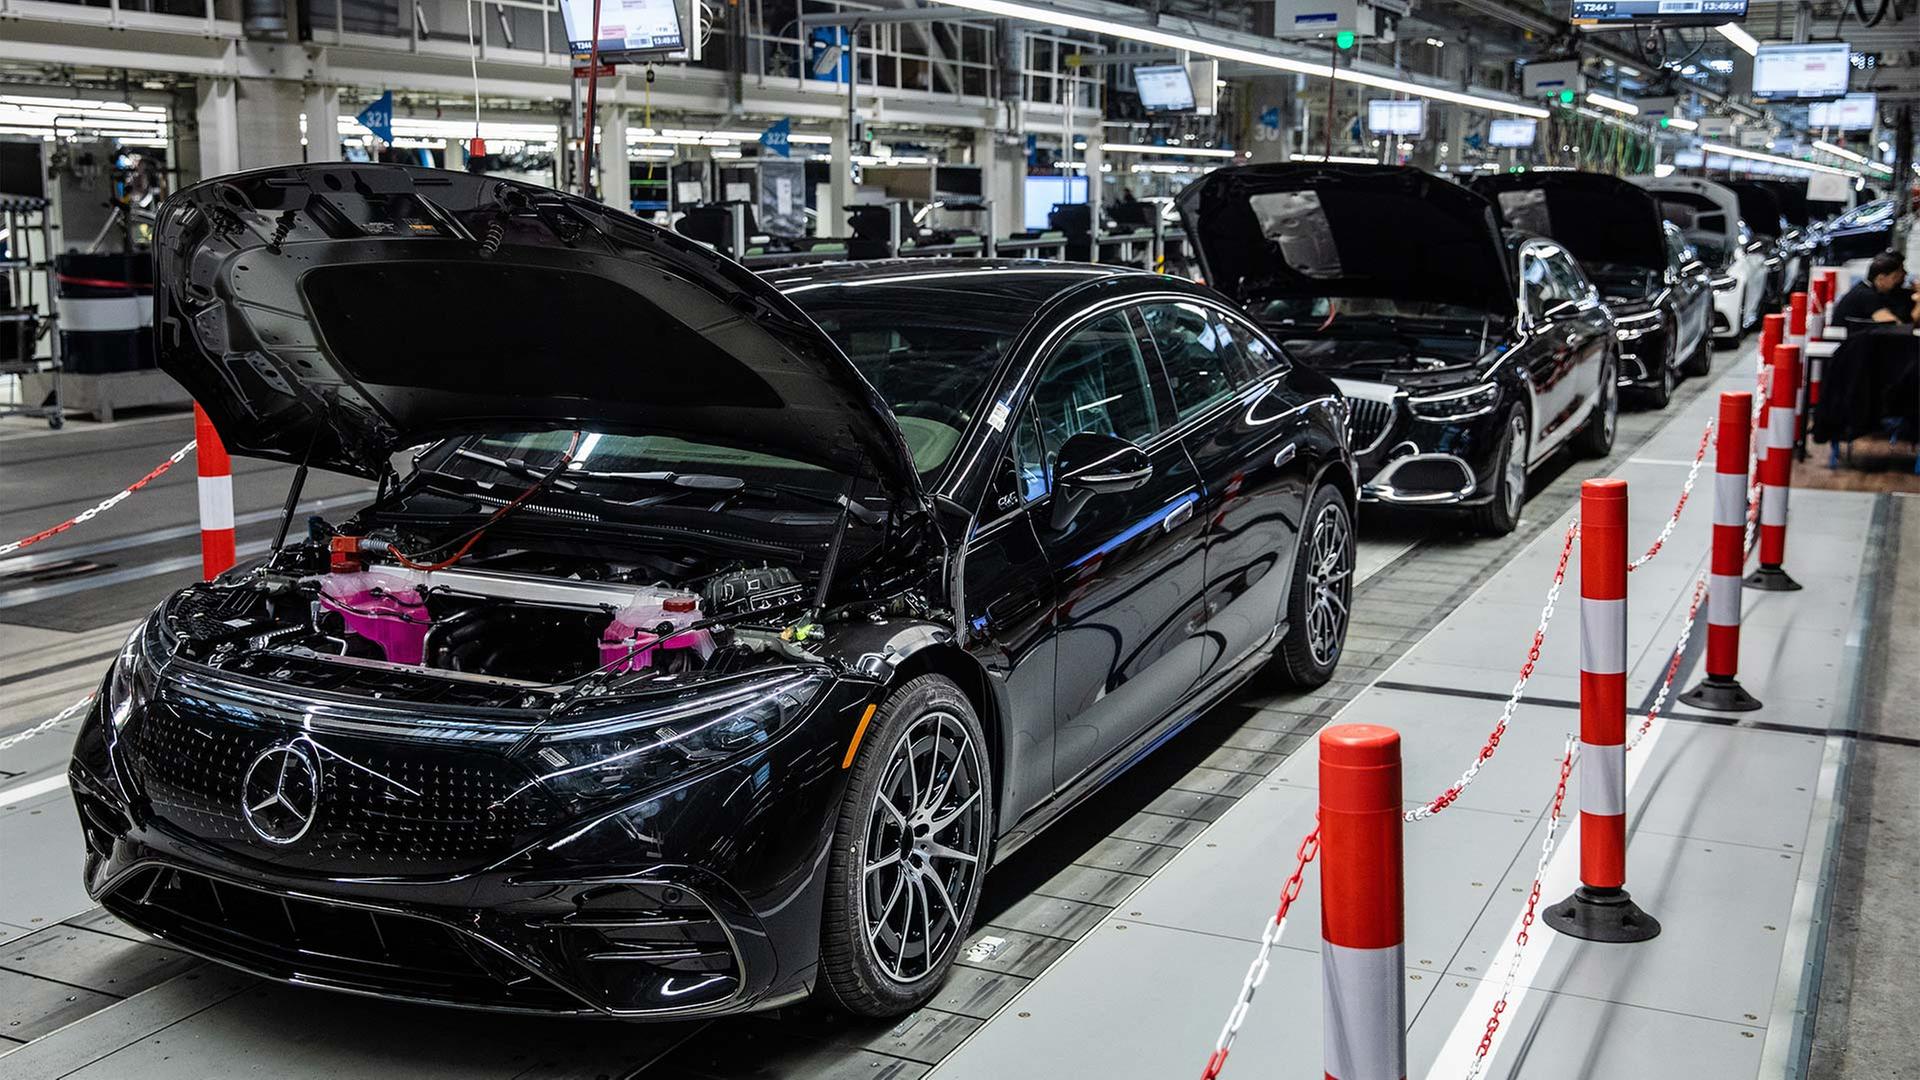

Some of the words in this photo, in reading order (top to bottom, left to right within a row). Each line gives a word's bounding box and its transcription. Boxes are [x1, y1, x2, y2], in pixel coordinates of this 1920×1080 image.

[1583, 3, 1608, 12] T244
[1703, 2, 1745, 11] 13:49:41
[367, 111, 389, 127] 321
